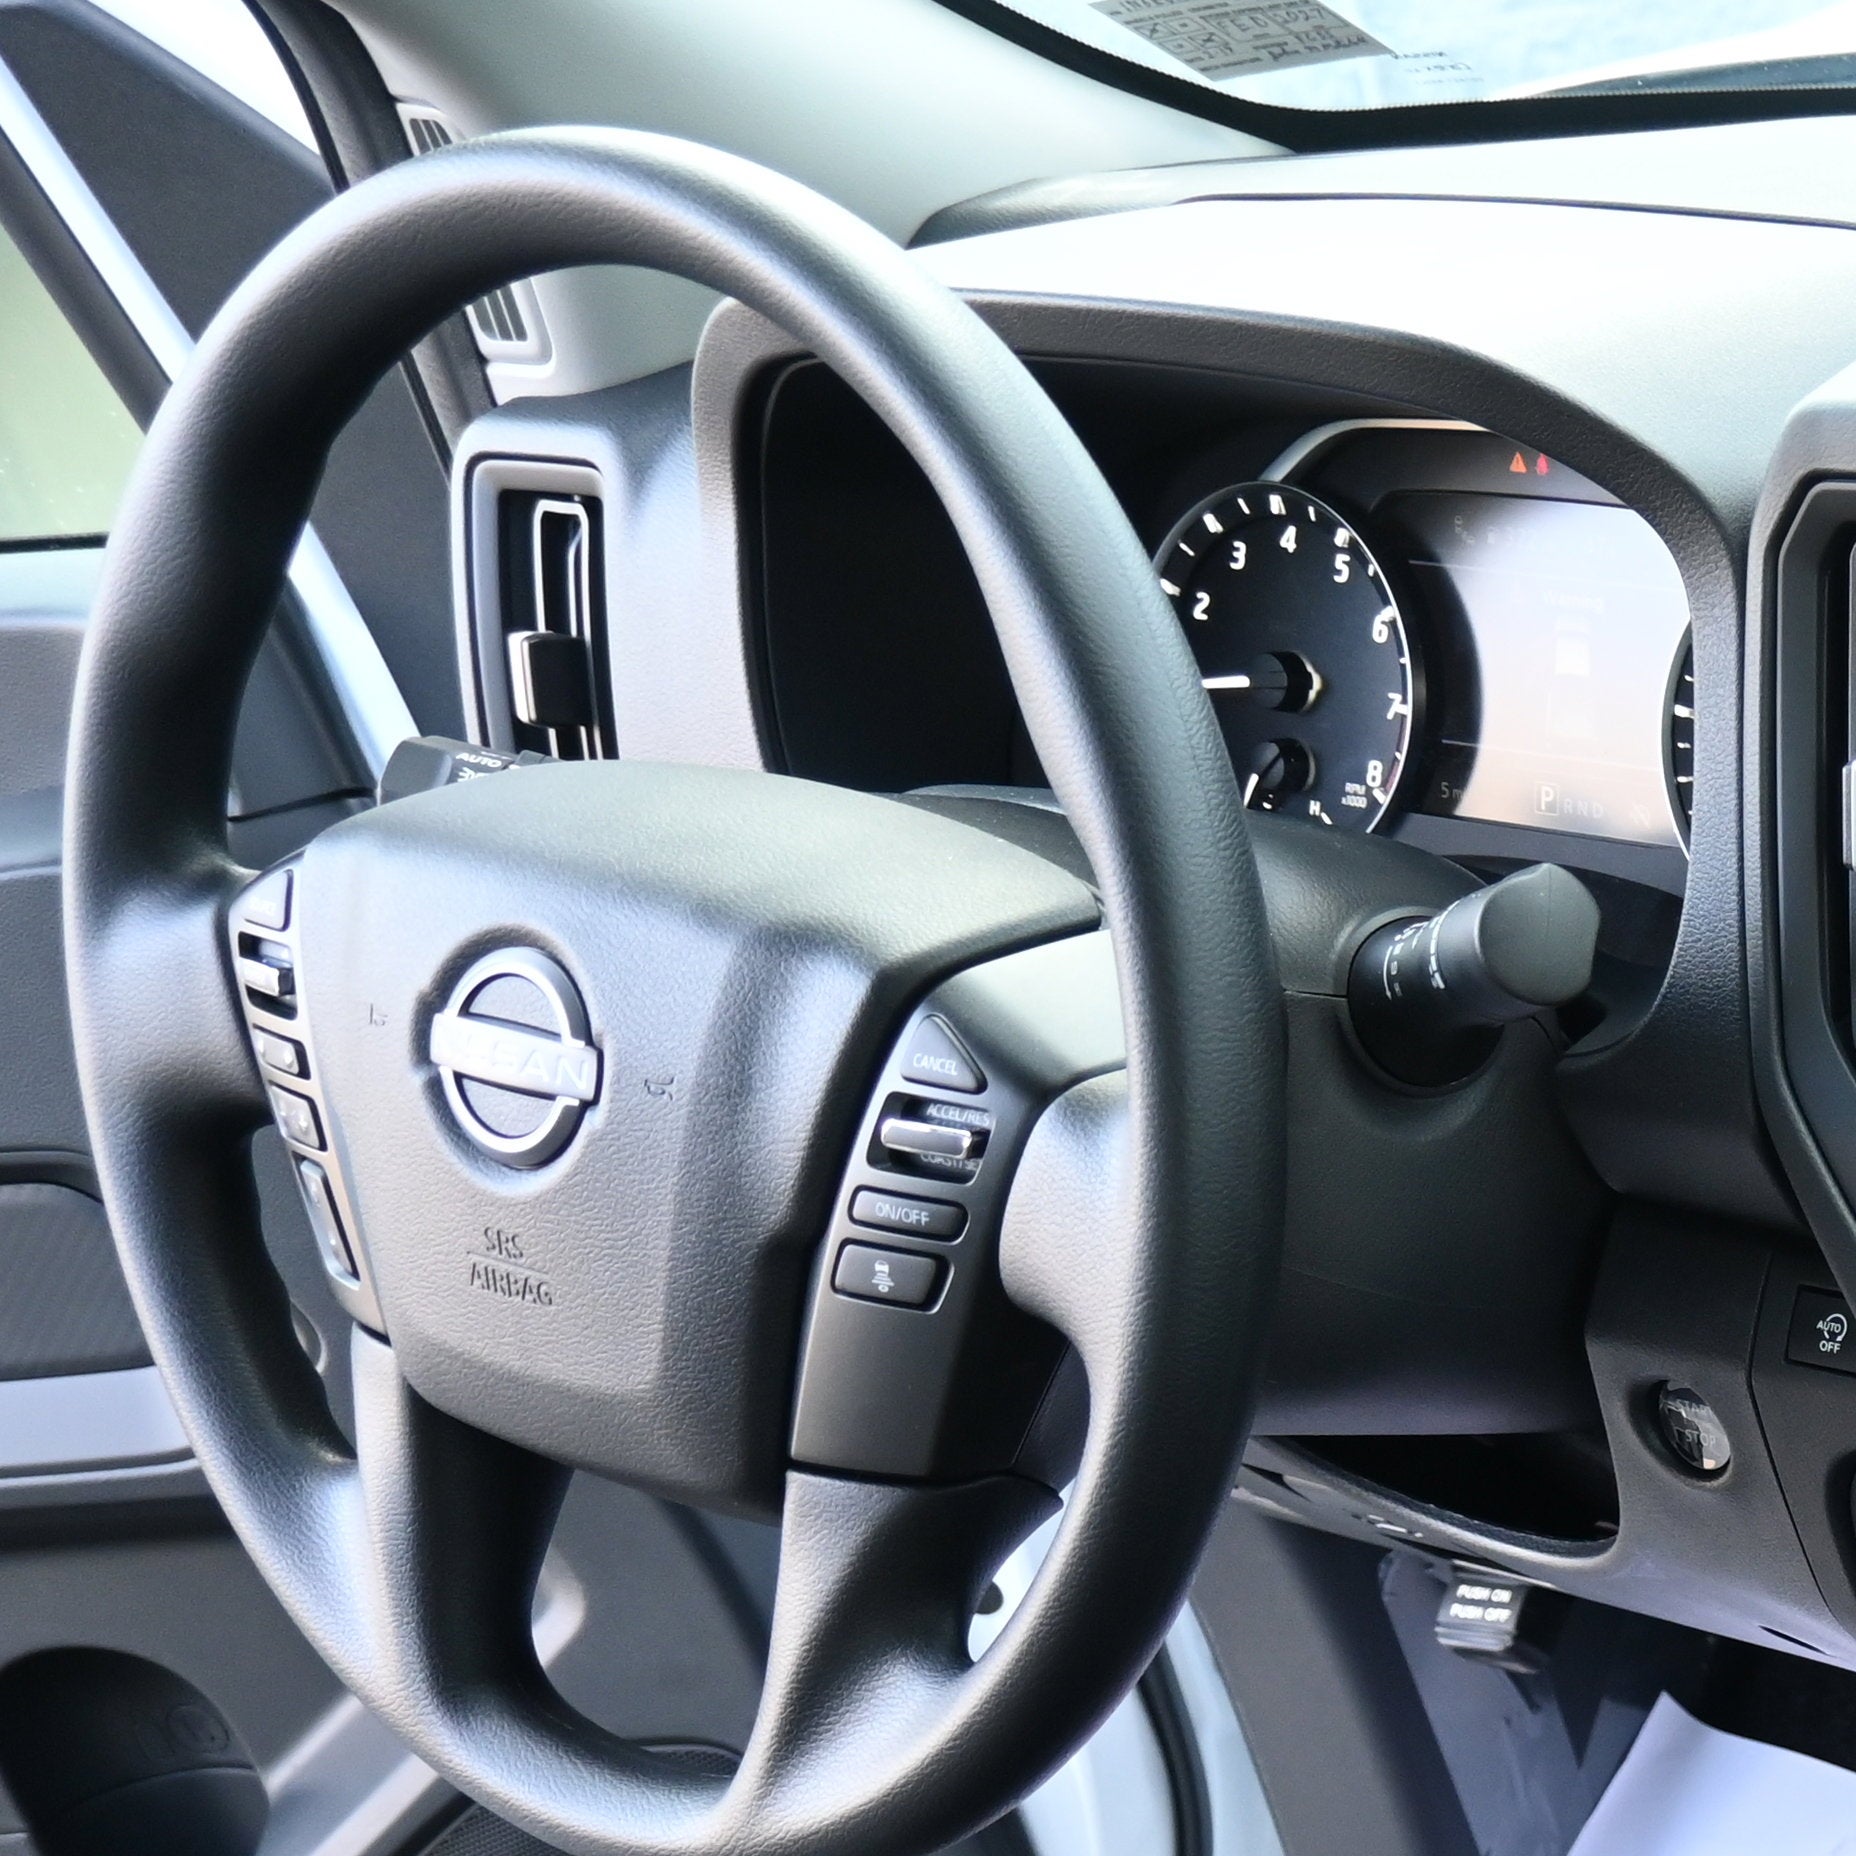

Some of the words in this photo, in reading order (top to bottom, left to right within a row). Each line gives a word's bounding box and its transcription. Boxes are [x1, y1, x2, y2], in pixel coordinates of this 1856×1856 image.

[1280, 525, 1297, 553] 4
[1229, 541, 1247, 570] 3
[1333, 554, 1350, 583] 5
[1193, 592, 1210, 620] 2
[1372, 614, 1389, 643] 6
[1387, 692, 1403, 720] 7
[455, 751, 502, 768] AUTO
[1366, 760, 1383, 788] 8
[1309, 801, 1321, 816] H
[1540, 787, 1555, 811] P
[912, 1053, 958, 1076] CANCEL
[926, 1102, 990, 1127] ACCEL/RES
[875, 1201, 931, 1227] ON/OFF
[484, 1226, 524, 1260] SRS
[470, 1262, 553, 1306] AIRBAG
[1816, 1319, 1842, 1333] AUTO
[1819, 1340, 1842, 1354] OFF
[1684, 1429, 1717, 1447] STOP
[1456, 1584, 1492, 1601] PUSH
[1491, 1588, 1512, 1603] ON
[1449, 1603, 1484, 1619] PUSH
[1484, 1607, 1512, 1623] OFF
